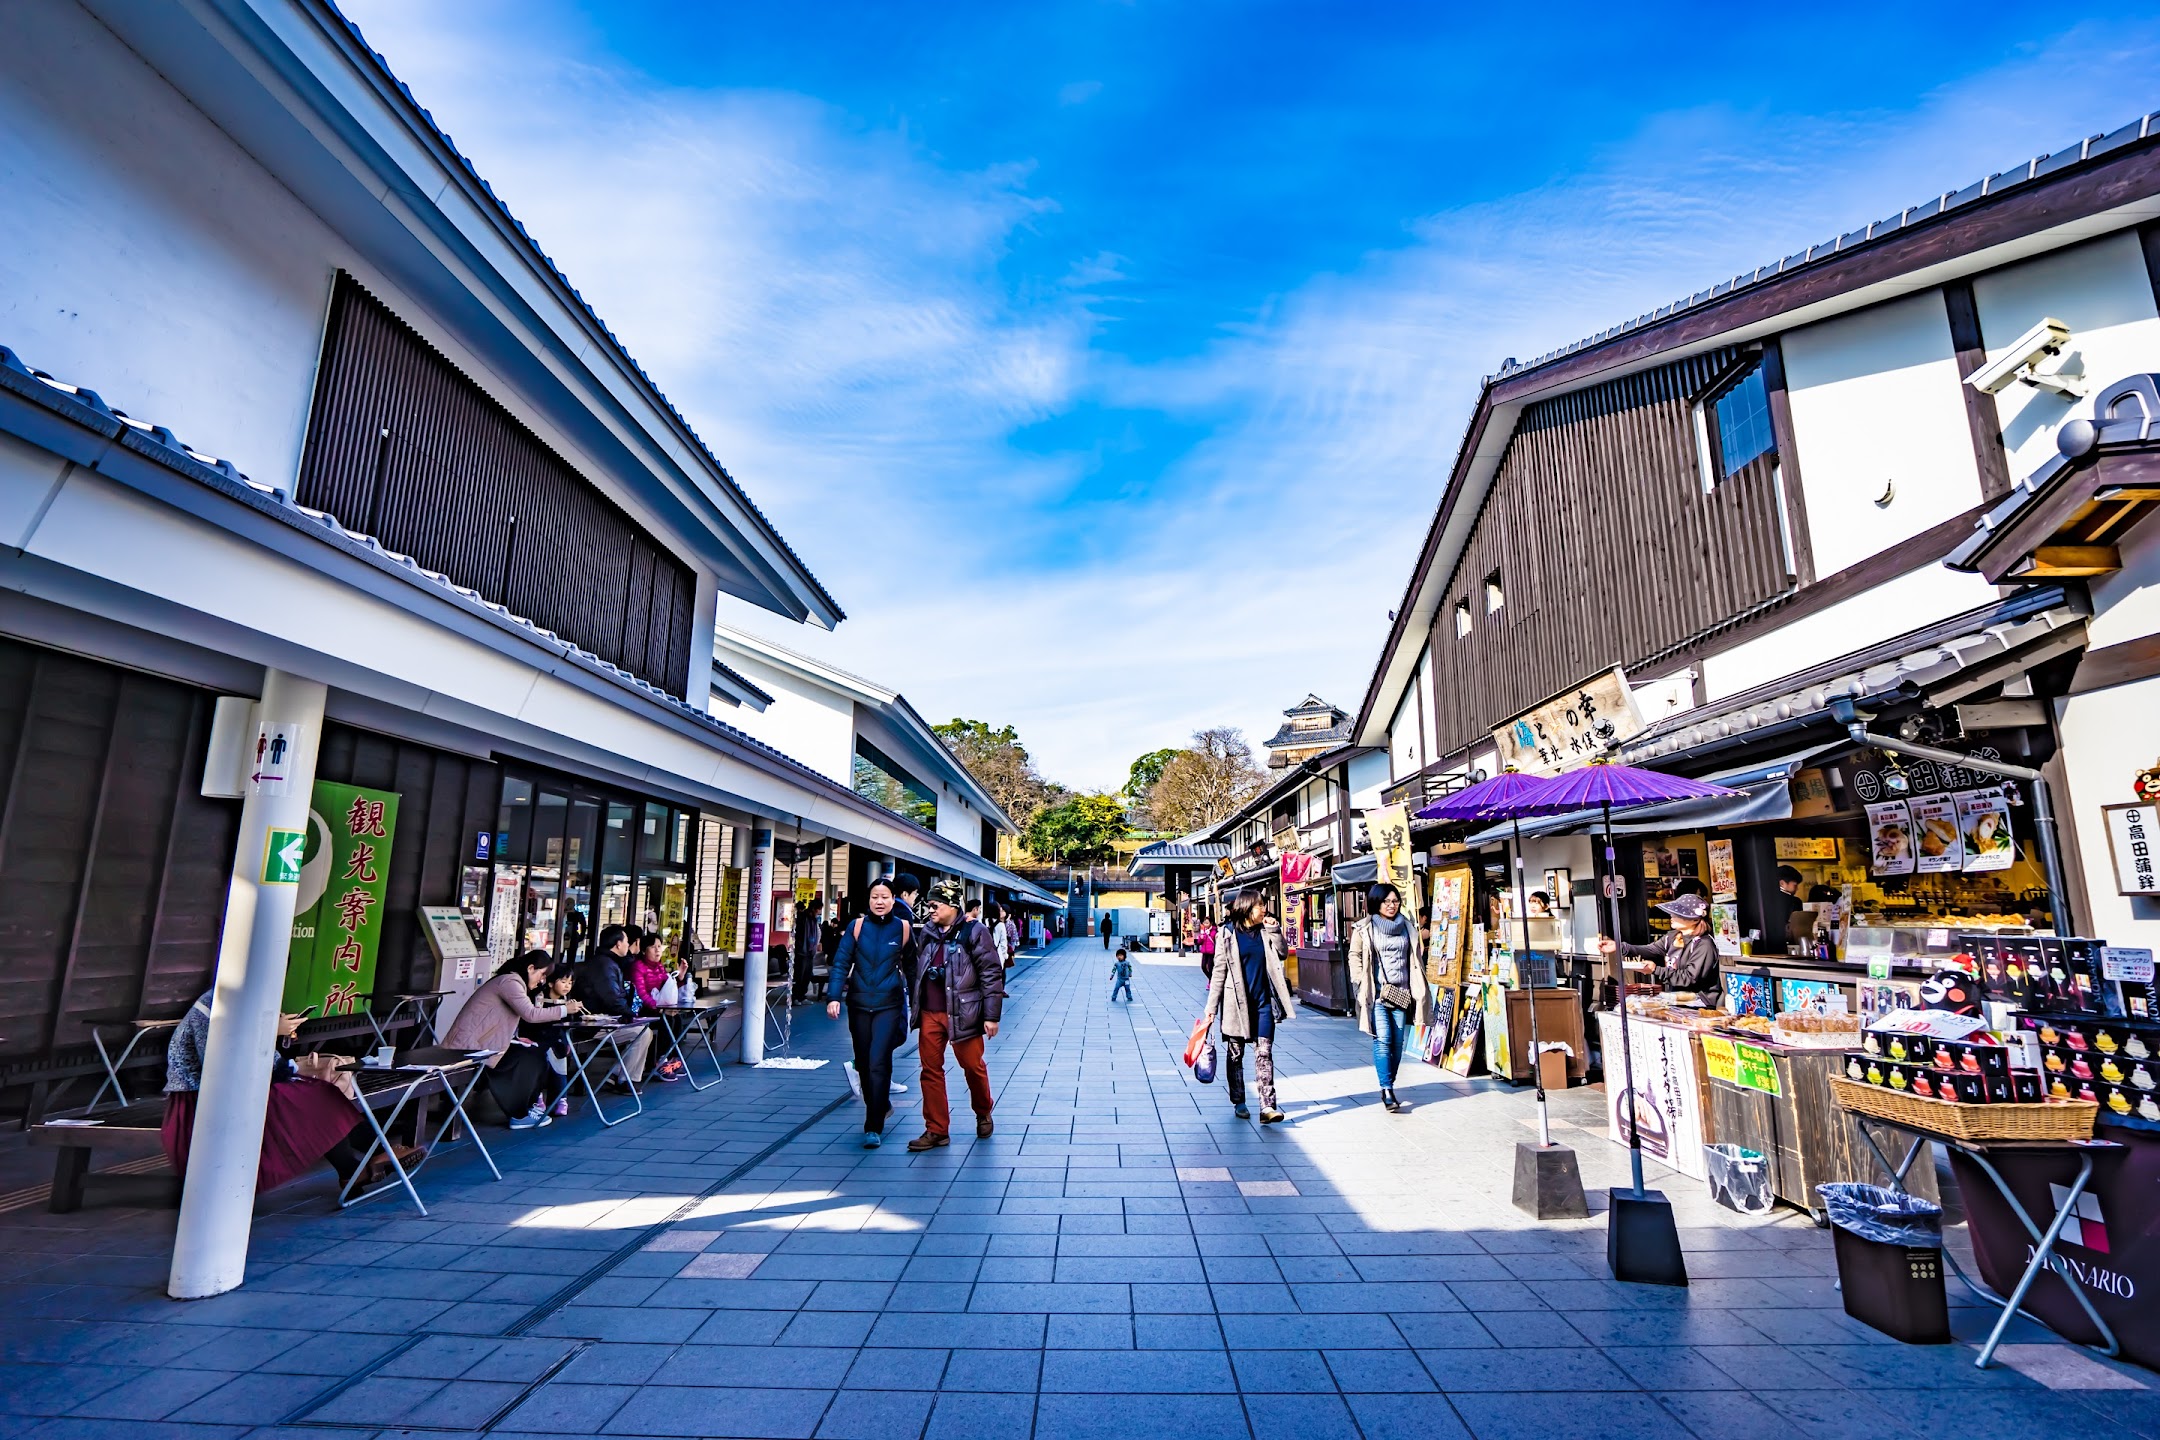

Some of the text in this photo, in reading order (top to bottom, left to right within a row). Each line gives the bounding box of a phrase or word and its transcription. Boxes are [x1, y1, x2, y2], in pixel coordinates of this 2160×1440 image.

[1570, 731, 1598, 755] 水俣
[2128, 825, 2155, 890] 高田蒲鉾
[323, 795, 387, 1018] 観光案内所
[751, 859, 763, 920] 総合観光案内所
[291, 922, 315, 939] tion
[2086, 947, 2102, 1004] MONARIO
[1720, 1065, 1736, 1078] ¥30
